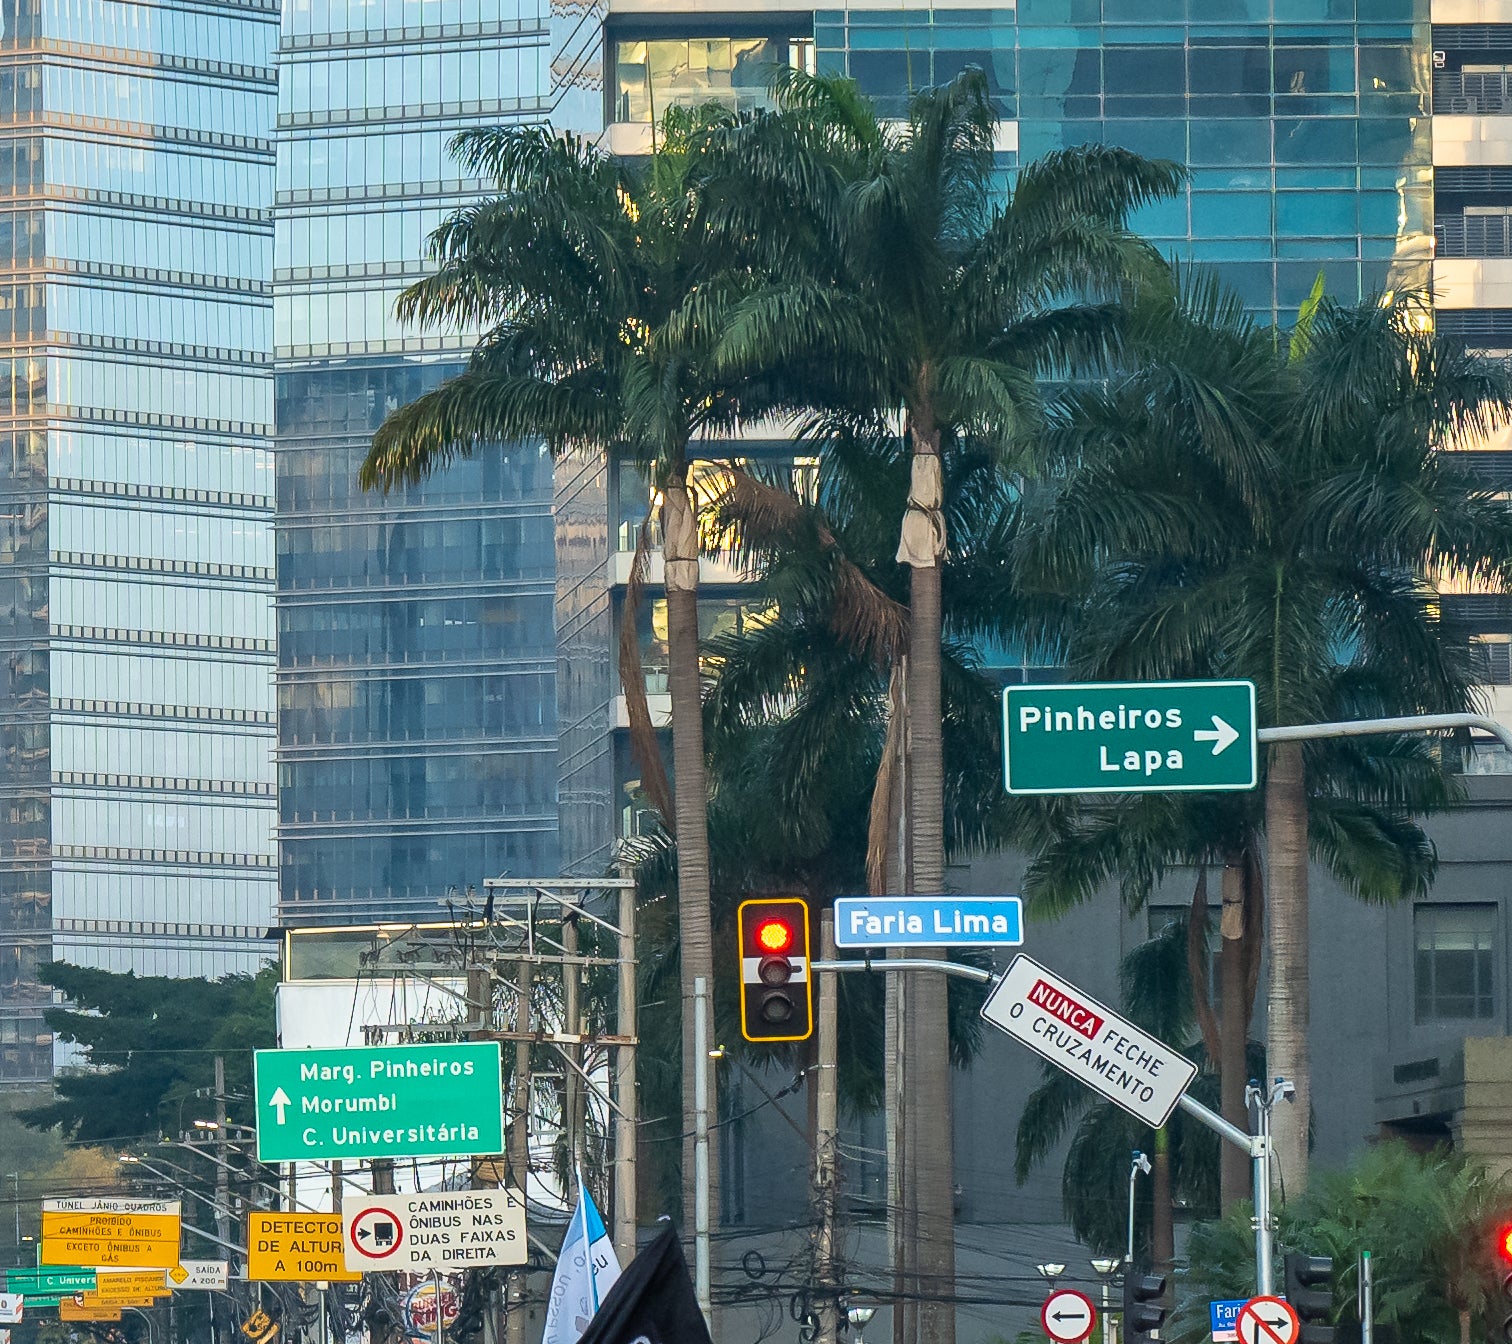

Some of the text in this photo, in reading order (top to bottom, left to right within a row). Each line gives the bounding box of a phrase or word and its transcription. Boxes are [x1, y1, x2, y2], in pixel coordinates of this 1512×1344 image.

[1020, 705, 1182, 732] Pinheiros
[1099, 747, 1184, 776] Lapa
[850, 908, 1008, 935] Faria Lima
[1031, 982, 1166, 1077] NUNCA FECHE
[1009, 1002, 1154, 1104] O CRUZAMENTO
[300, 1058, 475, 1084] Marg. Pinheiros
[302, 1094, 398, 1114] Morumbi
[302, 1121, 480, 1147] C. Universitária
[91, 1199, 118, 1211] JÂNIO
[408, 1197, 516, 1212] CAMINHÕES E
[90, 1216, 132, 1226] PROIBIDO
[410, 1214, 504, 1229] ÔNIBUS NAS
[60, 1224, 112, 1237] CAMINHÕES
[129, 1226, 162, 1238] ÔNIBUS
[410, 1230, 516, 1246] DUAS FAIXAS
[66, 1242, 100, 1252] EXCETO
[108, 1241, 140, 1253] ÔNIBUS
[258, 1241, 280, 1253] DE
[411, 1247, 497, 1262] DA DIREITA
[196, 1265, 221, 1274] SAÍDA
[275, 1260, 338, 1273] A 100m
[200, 1277, 216, 1285] 200
[1216, 1304, 1241, 1319] Fari
